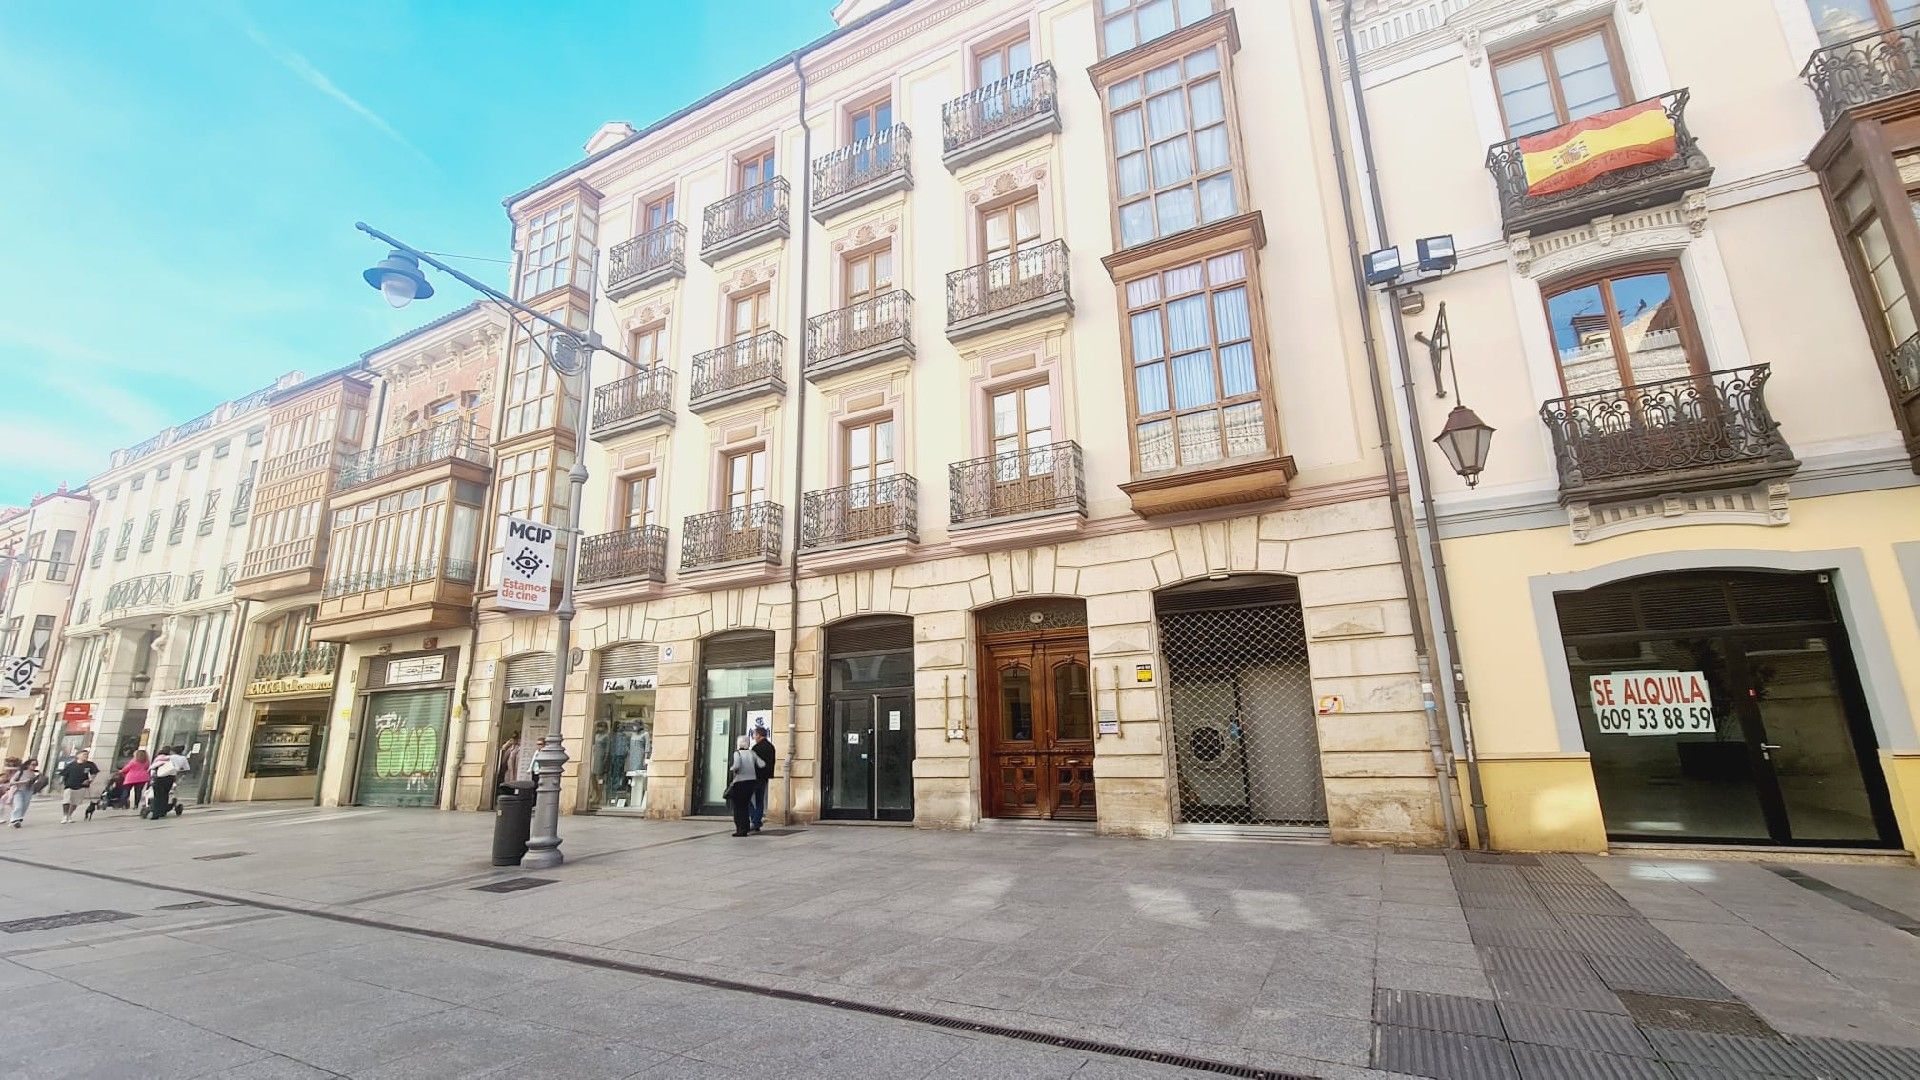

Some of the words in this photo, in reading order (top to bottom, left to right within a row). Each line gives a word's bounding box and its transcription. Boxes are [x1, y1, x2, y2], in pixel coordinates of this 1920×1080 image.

[510, 521, 552, 543] MCIP
[502, 588, 514, 598] de
[516, 591, 538, 601] cine
[503, 578, 547, 593] Estamos
[1593, 679, 1615, 705] SE
[1624, 676, 1706, 705] ALQUILA
[1601, 708, 1631, 729] 609
[1638, 708, 1658, 729] 53
[1663, 707, 1684, 729] 88
[1690, 707, 1710, 729] 59
